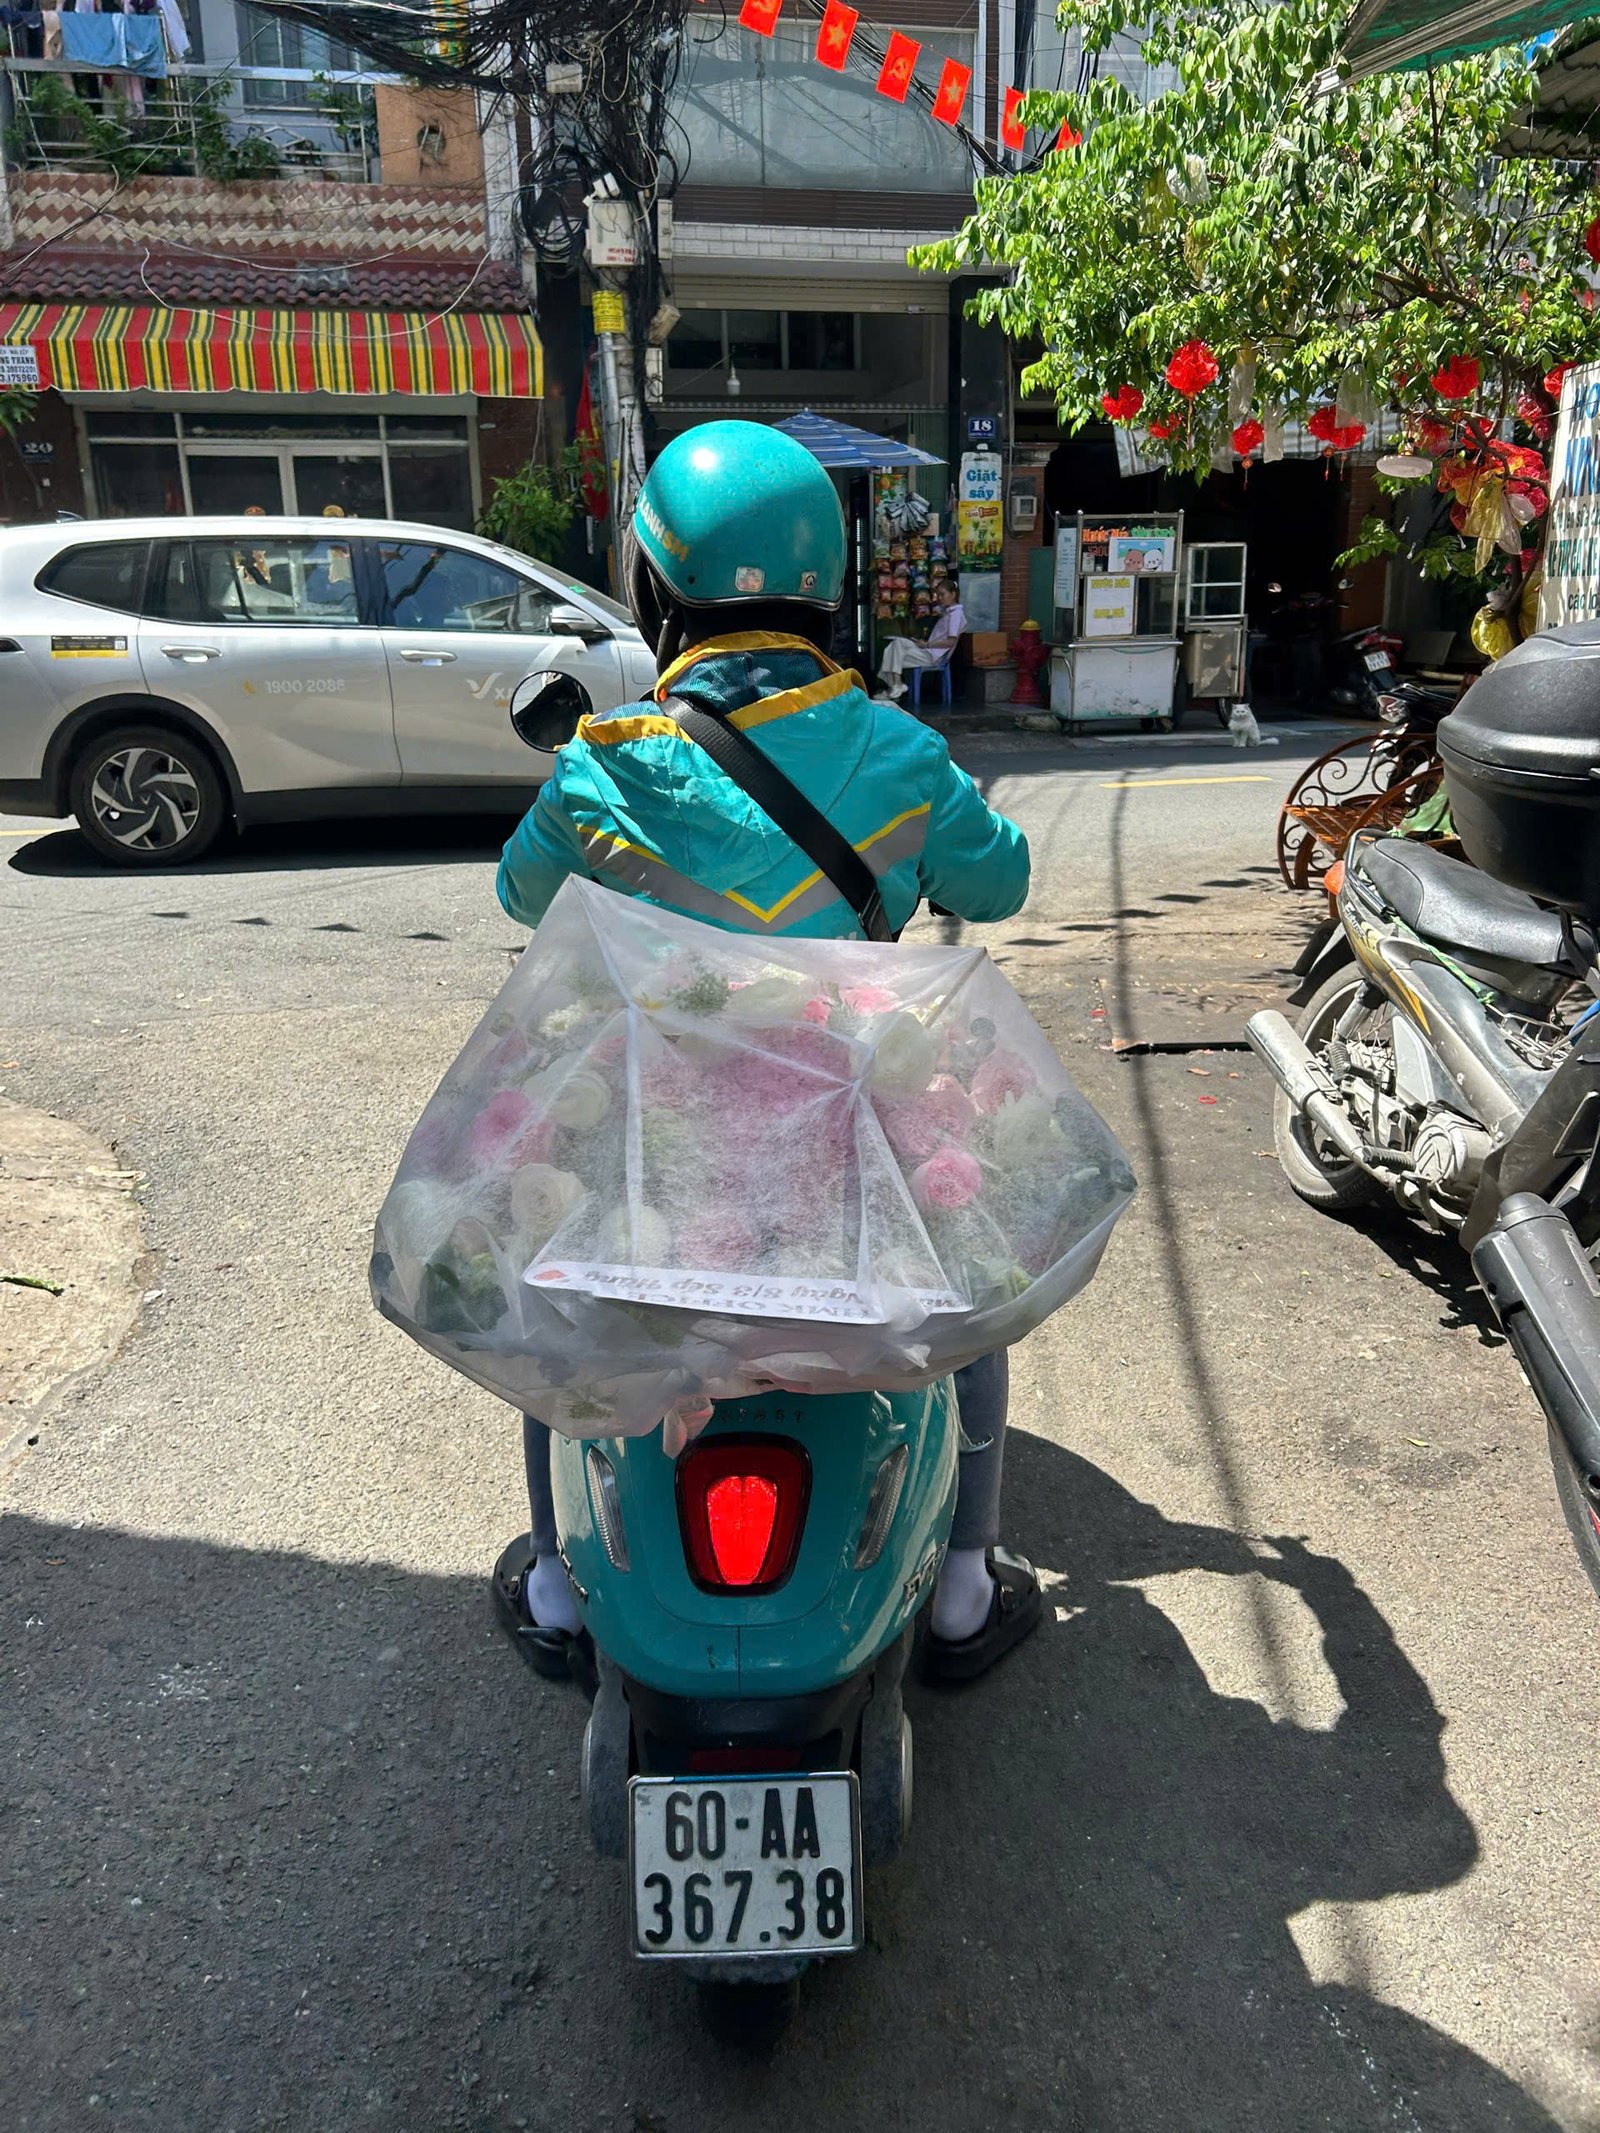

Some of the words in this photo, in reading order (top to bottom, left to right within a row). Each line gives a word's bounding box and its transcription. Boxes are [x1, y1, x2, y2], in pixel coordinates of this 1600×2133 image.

[972, 420, 992, 431] 18
[966, 469, 998, 485] Giặt
[969, 484, 994, 500] sấy
[265, 679, 303, 694] 1900
[732, 1283, 783, 1299] 8/3
[664, 1786, 821, 1862] 60-AA
[643, 1867, 846, 1945] 367.38
